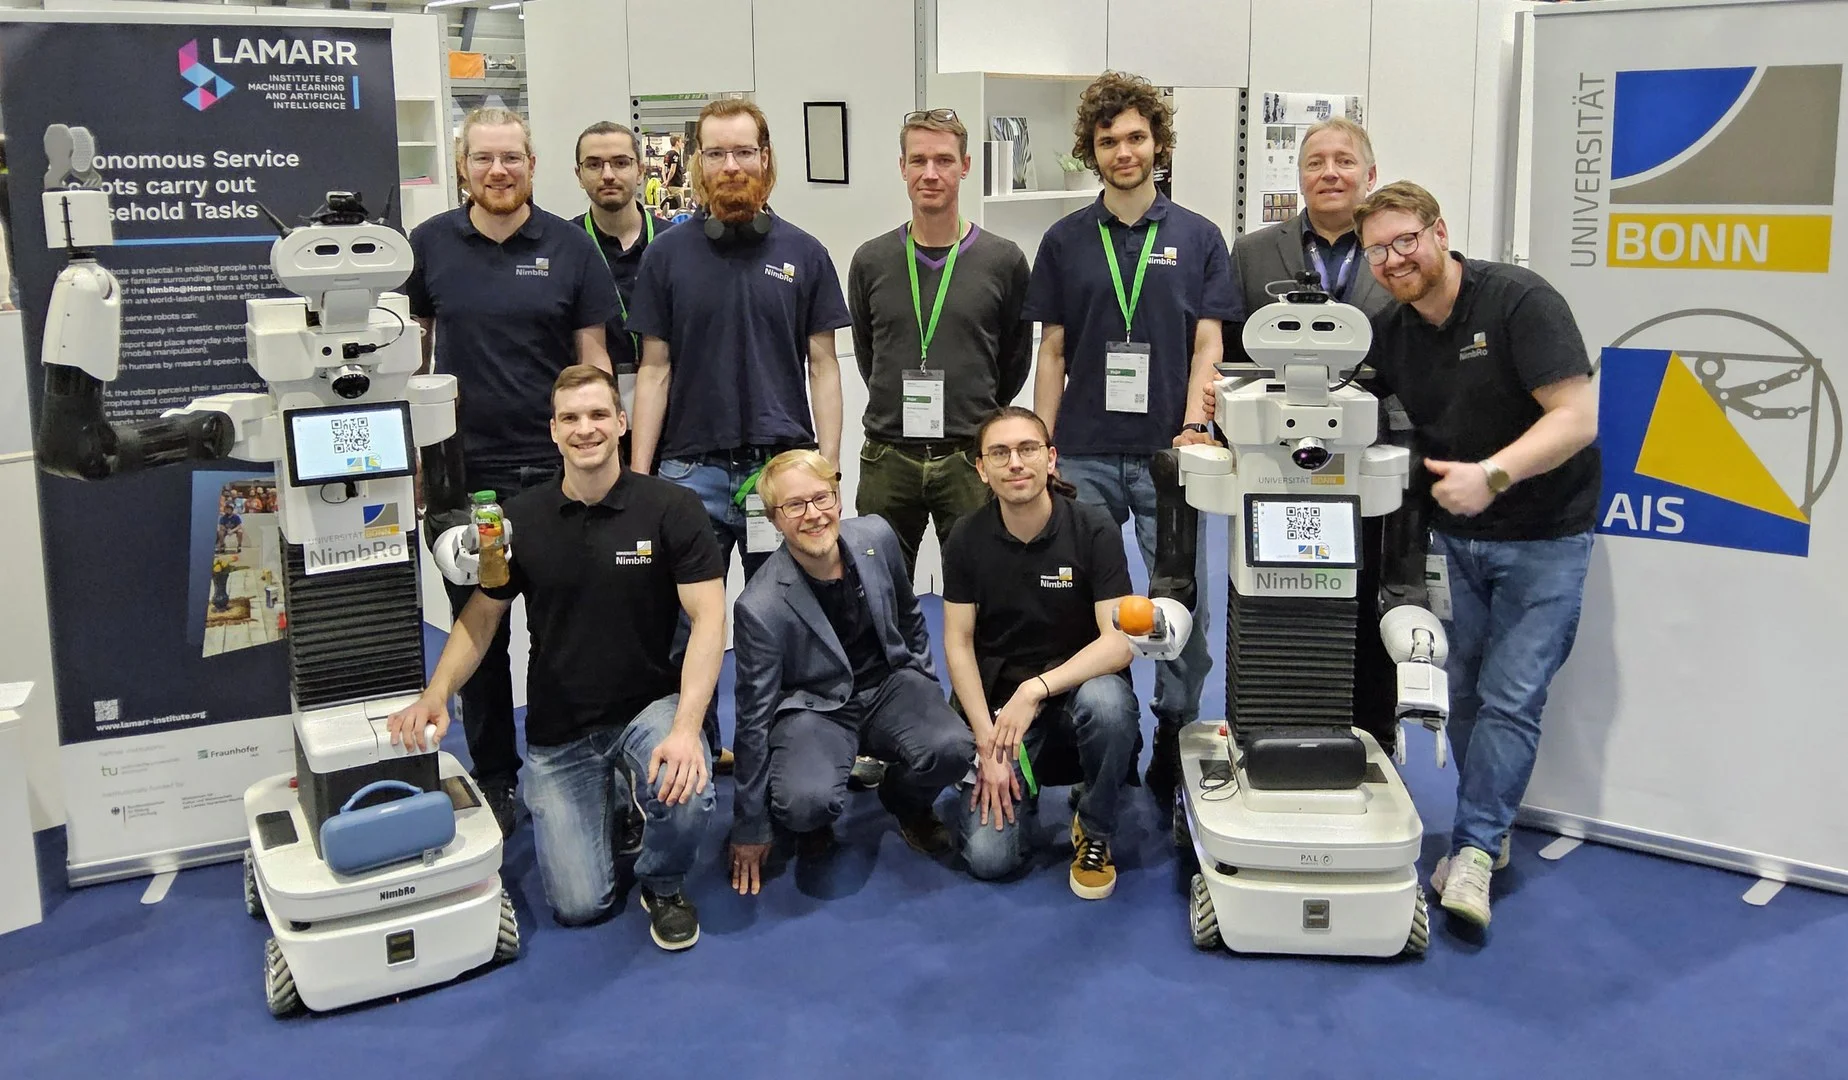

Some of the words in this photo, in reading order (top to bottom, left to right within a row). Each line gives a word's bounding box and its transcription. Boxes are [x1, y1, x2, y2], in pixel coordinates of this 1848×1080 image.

[213, 38, 358, 65] LAMARR
[269, 74, 321, 83] INSTITUTE
[324, 75, 345, 83] FOR
[248, 83, 292, 91] MACHINE
[295, 84, 345, 92] LEARNING
[265, 92, 287, 100] AND
[290, 92, 346, 101] ARTIFICIAL
[273, 101, 346, 110] INTELLIGENCE
[92, 154, 206, 169] onomous
[213, 149, 300, 168] Service
[1570, 72, 1605, 267] UNIVERSITÄT
[146, 179, 208, 198] carry
[215, 176, 257, 194] out
[109, 201, 184, 221] sehold
[190, 200, 259, 220] Tasks
[1615, 221, 1769, 264] BONN
[146, 266, 173, 275] pivotal
[184, 265, 219, 273] enabling
[220, 264, 247, 272] people
[515, 268, 549, 277] NimbRo
[764, 267, 793, 283] NimbRo
[130, 277, 161, 285] familiar
[163, 275, 215, 283] surroundings
[240, 273, 258, 282] long
[120, 287, 129, 295] of
[131, 287, 145, 295] the
[146, 284, 212, 294] NimbRo@Home
[235, 283, 245, 291] at
[245, 282, 259, 290] the
[150, 295, 206, 304] world-leading
[125, 313, 153, 322] service
[153, 312, 180, 321] robots
[176, 324, 213, 333] domestic
[146, 339, 162, 347] and
[163, 339, 185, 348] place
[186, 336, 222, 345] everyday
[222, 335, 247, 344] object
[128, 362, 162, 370] humans
[162, 361, 173, 370] by
[174, 360, 202, 368] means
[202, 358, 212, 366] of
[212, 356, 241, 366] speech
[114, 389, 129, 397] the
[129, 388, 156, 396] robots
[157, 386, 190, 396] perceive
[191, 384, 211, 392] their
[211, 382, 261, 391] surroundings
[141, 397, 157, 405] and
[158, 395, 187, 404] control
[112, 408, 134, 417] tasks
[1602, 492, 1685, 535] AIS
[309, 541, 402, 568] NimbRo
[615, 556, 652, 565] NimbRo
[1040, 579, 1073, 589] NimbRo
[1256, 572, 1342, 590] NimbRo
[96, 710, 207, 731] www.lamarr-institute.org
[210, 745, 260, 758] Fraunhofer
[100, 765, 118, 776] tu
[380, 886, 416, 901] NimbRo
